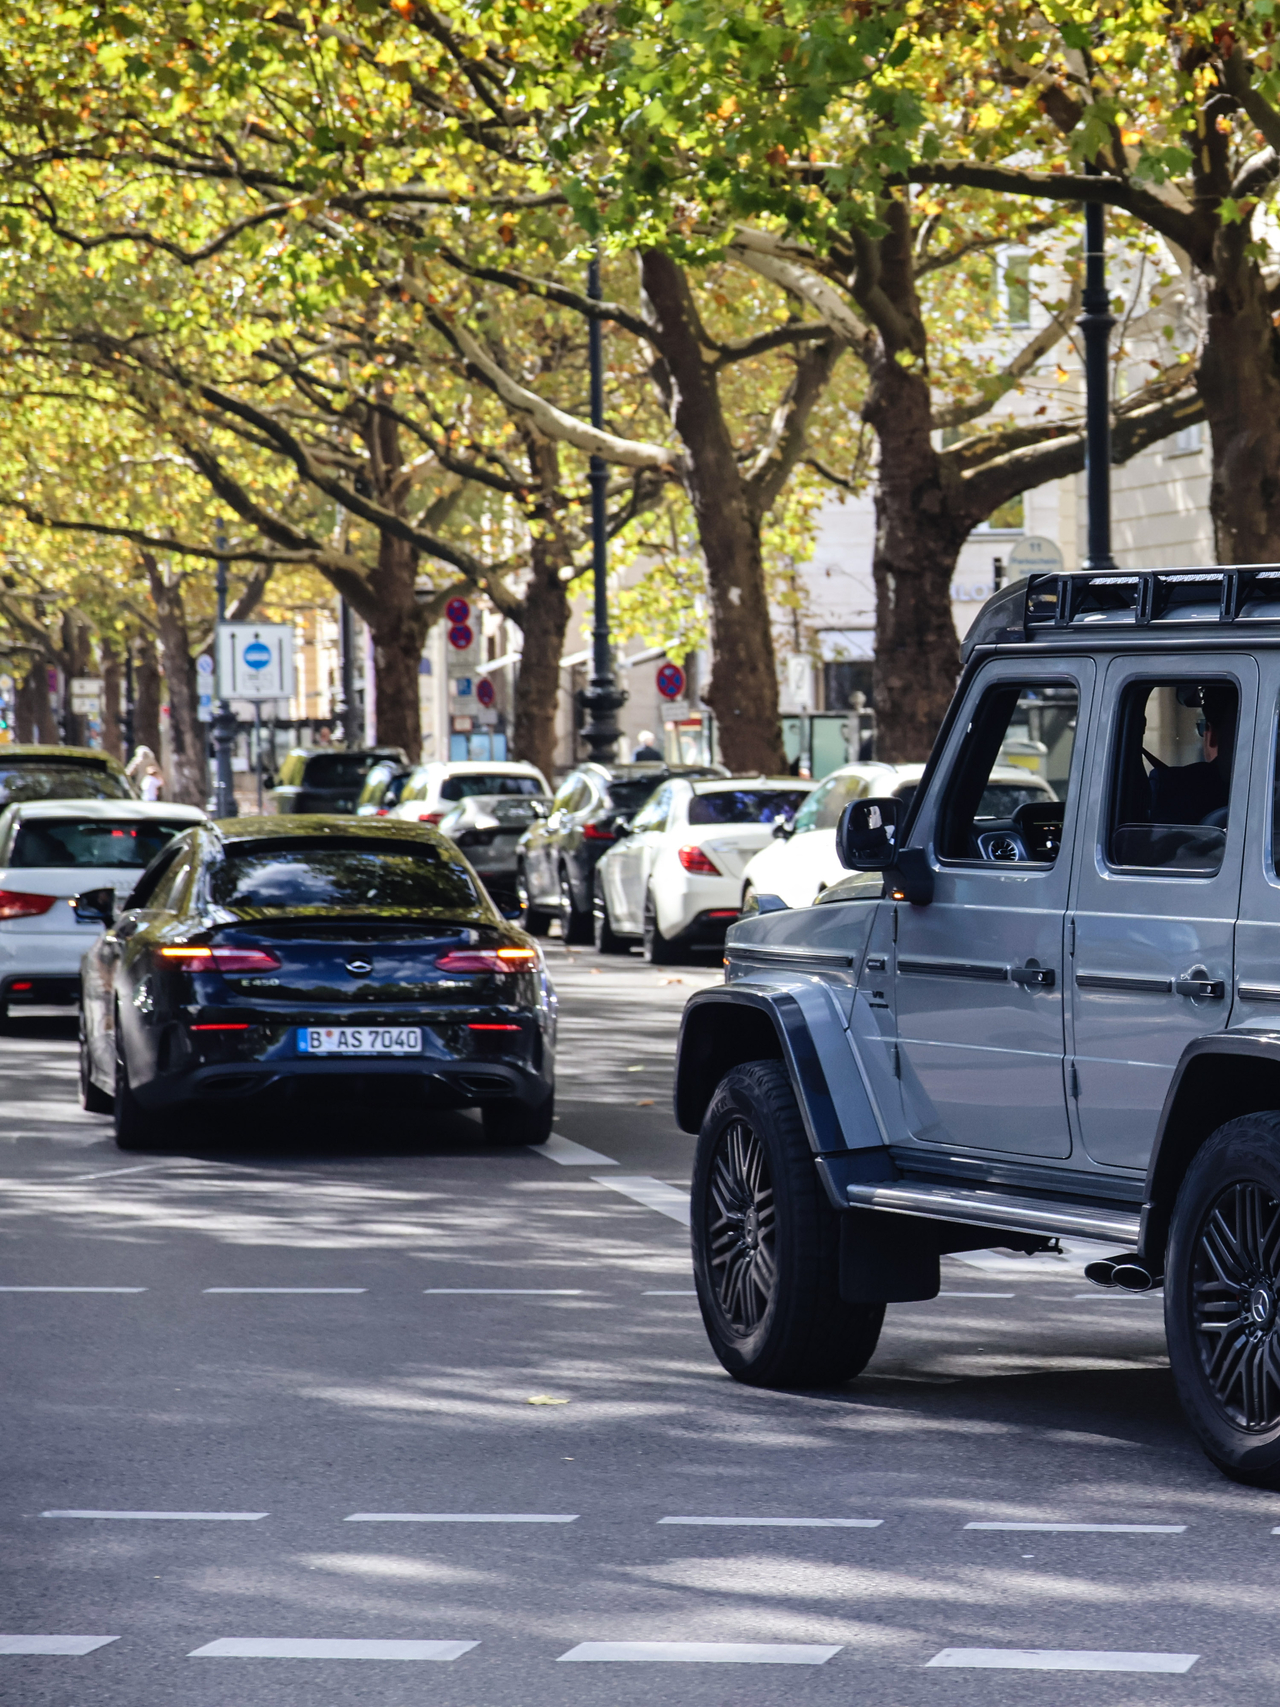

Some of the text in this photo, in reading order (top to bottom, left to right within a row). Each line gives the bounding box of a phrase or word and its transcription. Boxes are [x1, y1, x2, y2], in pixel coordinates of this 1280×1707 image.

[309, 1029, 418, 1049] B AS 7040
